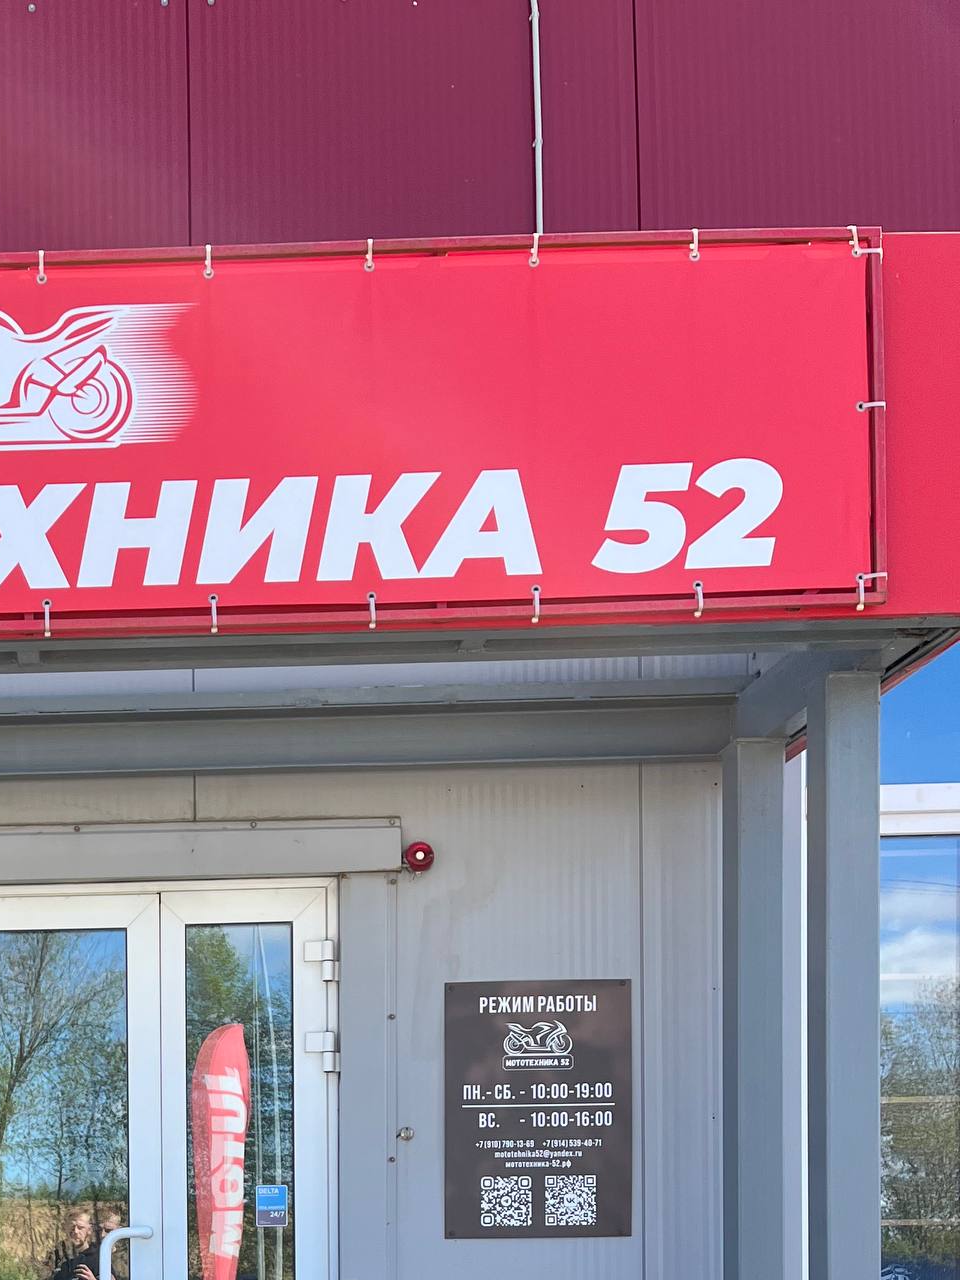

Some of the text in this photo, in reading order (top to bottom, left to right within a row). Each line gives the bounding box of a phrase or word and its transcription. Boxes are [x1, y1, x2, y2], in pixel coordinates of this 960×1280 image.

[590, 457, 785, 574] 52
[479, 994, 597, 1014] РЕЖИМ РАБОТЫ
[505, 1058, 570, 1067] МОТОТЕХНИКА 52
[530, 1082, 613, 1099] 10:00-19:00
[478, 1112, 500, 1128] ВС.
[530, 1110, 613, 1127] 10:00-16:00
[202, 1066, 248, 1258] MOTUL
[494, 1149, 583, 1159] mototehnika52@yandex.ru
[505, 1159, 572, 1169] мототехника-52.рф
[269, 1210, 285, 1218] 24/7
